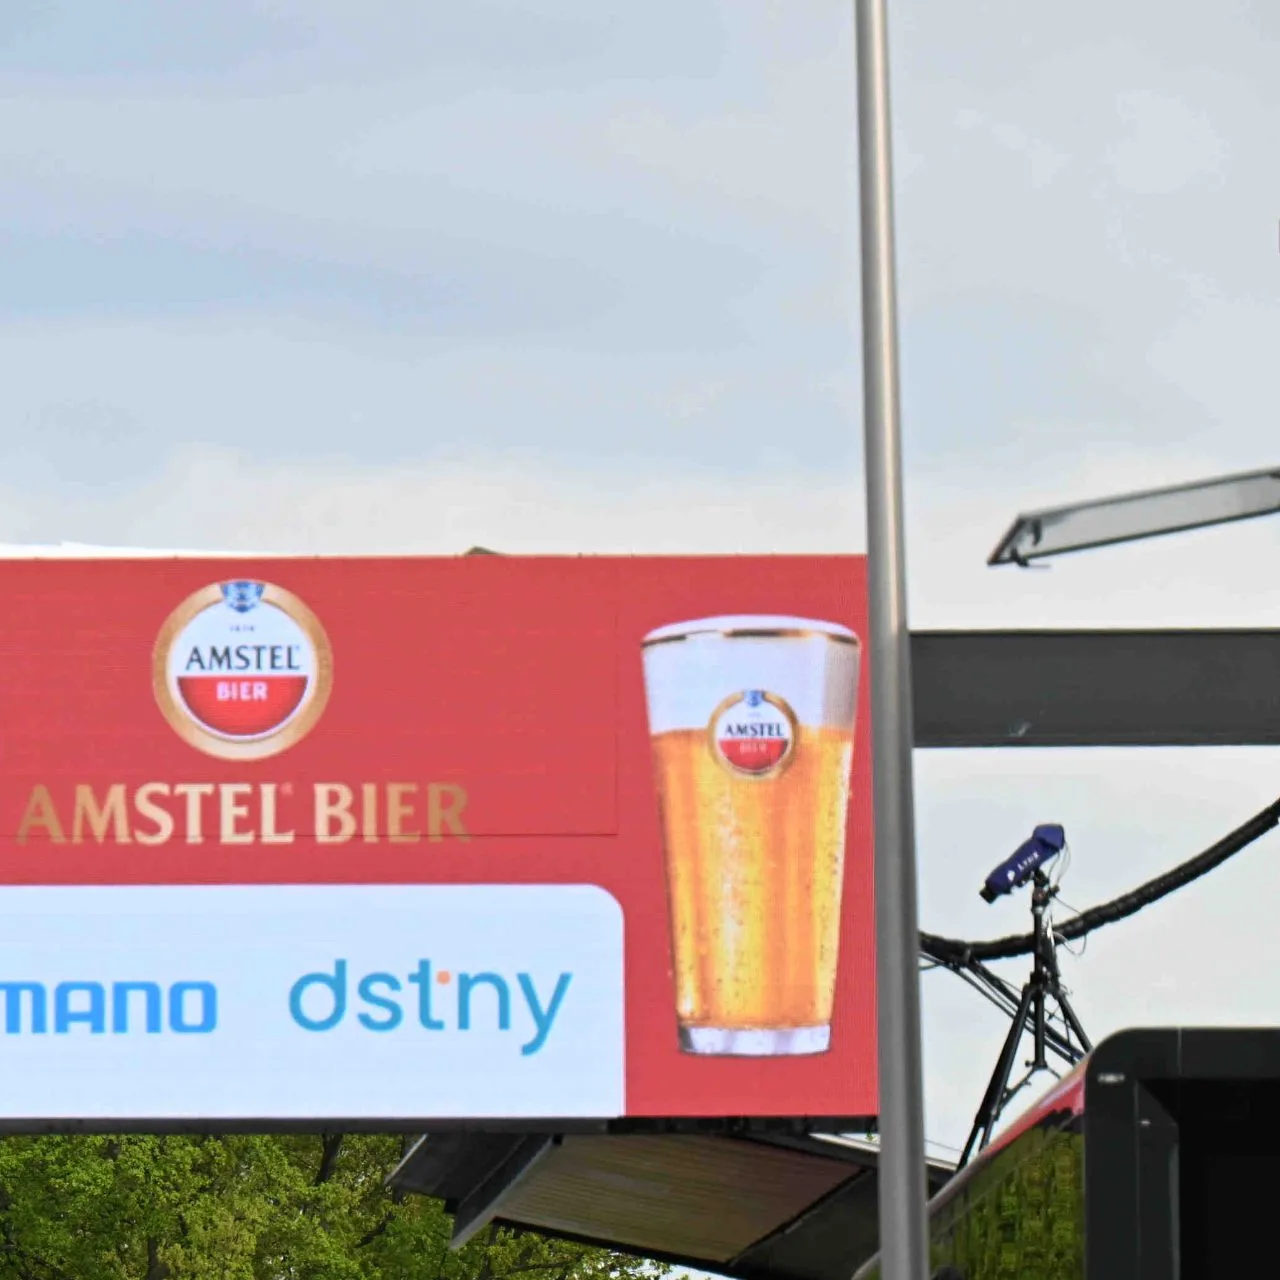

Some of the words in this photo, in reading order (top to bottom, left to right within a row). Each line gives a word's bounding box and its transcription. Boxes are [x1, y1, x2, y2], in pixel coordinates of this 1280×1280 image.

[185, 645, 302, 671] AMSTEL
[216, 681, 268, 702] BIER
[725, 722, 785, 737] AMSTEL
[16, 781, 296, 846] AMSTEL
[313, 782, 473, 845] BIER
[287, 957, 573, 1056] dstny
